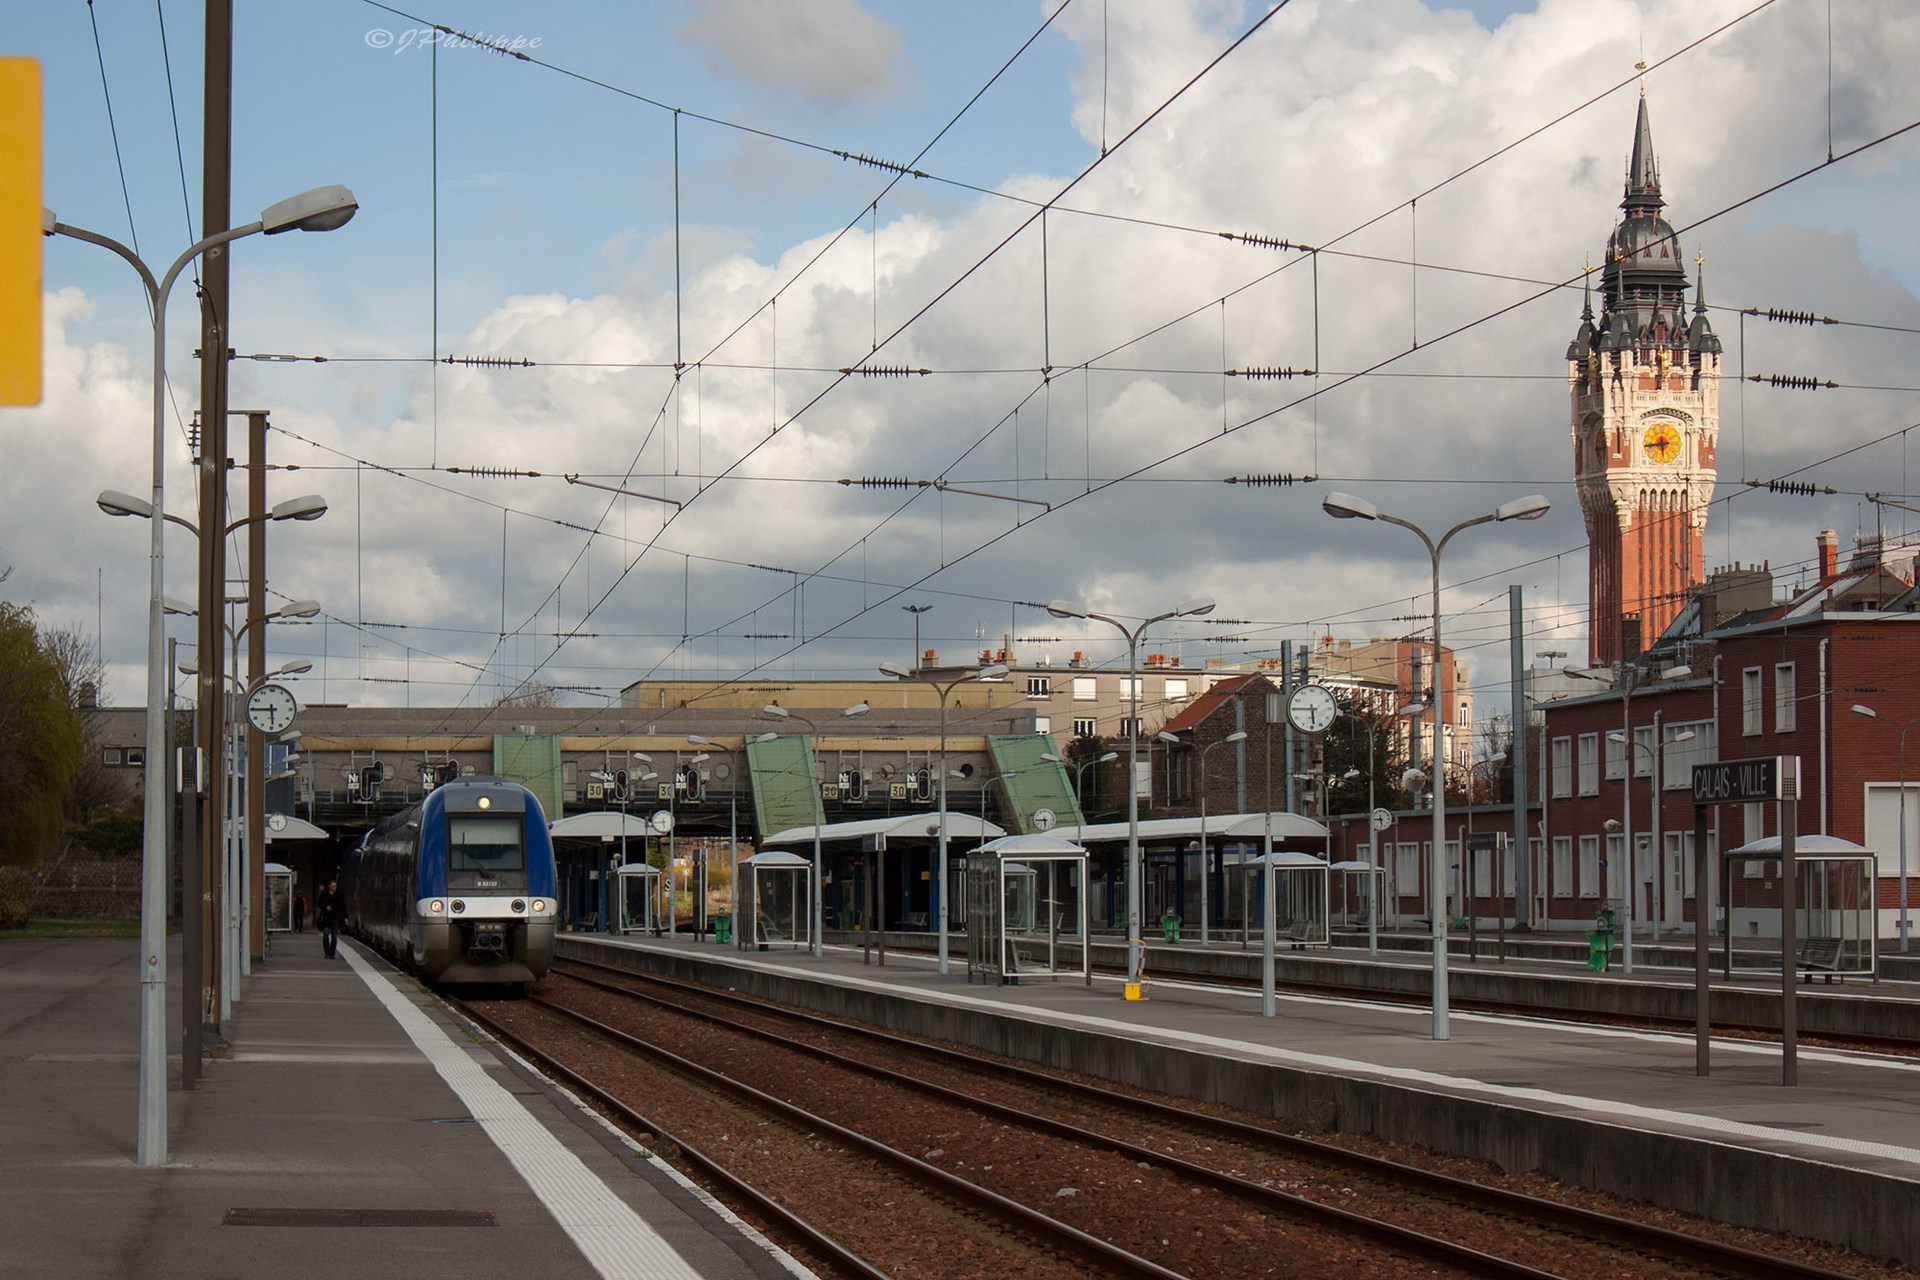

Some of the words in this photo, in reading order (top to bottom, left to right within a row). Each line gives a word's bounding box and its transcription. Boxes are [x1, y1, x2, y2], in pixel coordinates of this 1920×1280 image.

[1694, 766, 1730, 799] CALAIS
[1739, 764, 1767, 796] VILLE
[589, 785, 602, 796] 30
[660, 786, 672, 796] 30
[892, 785, 905, 796] 30
